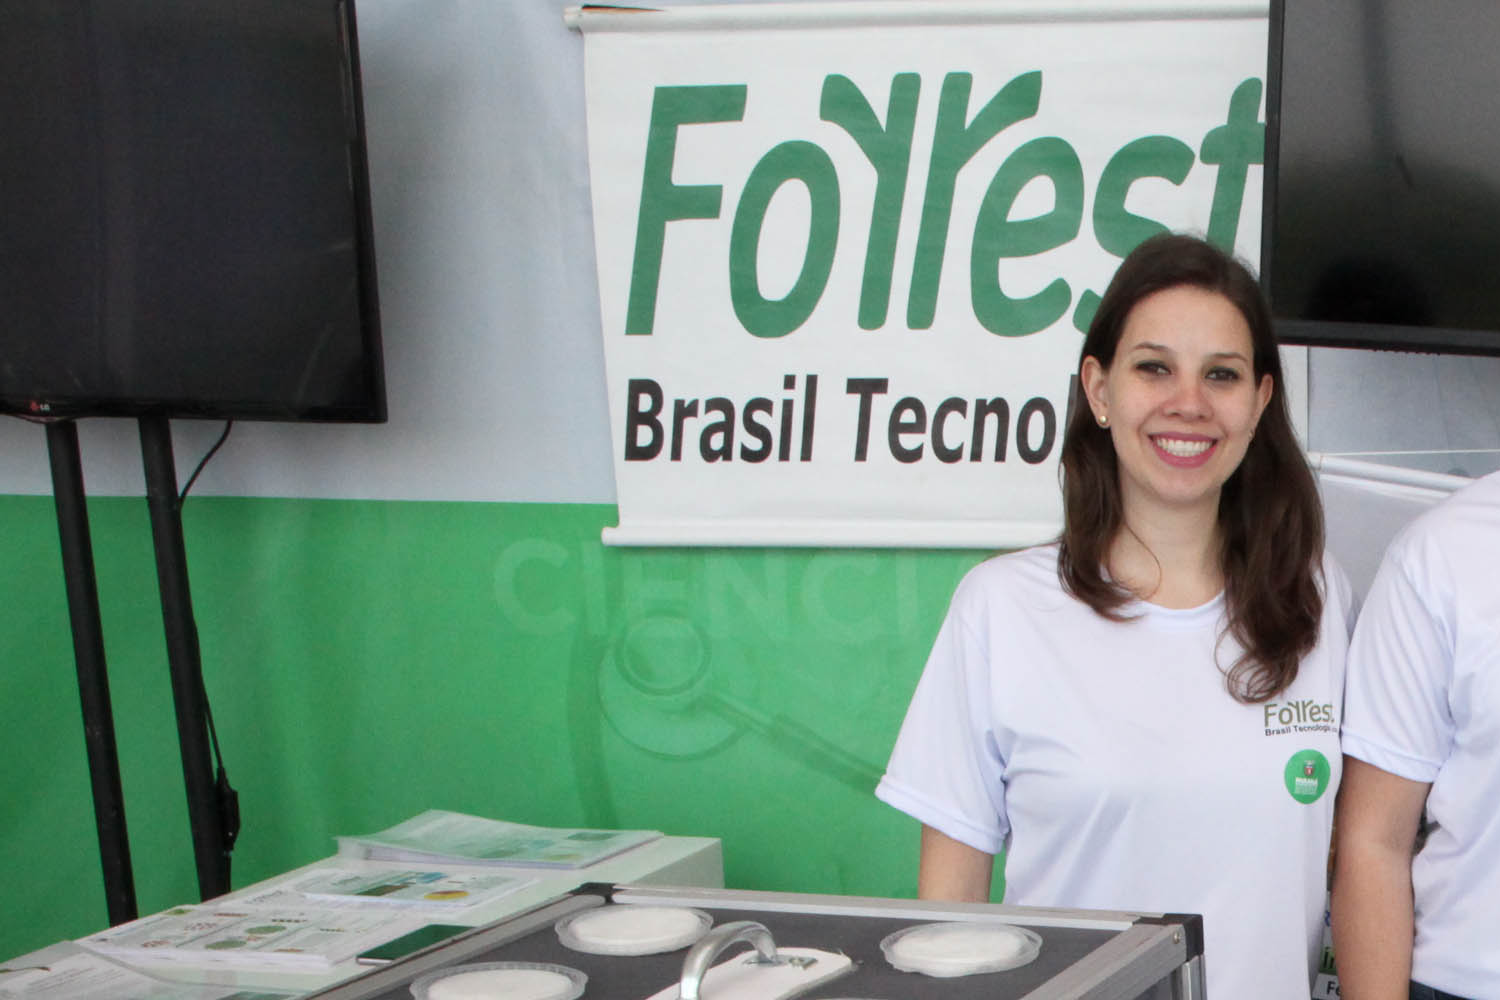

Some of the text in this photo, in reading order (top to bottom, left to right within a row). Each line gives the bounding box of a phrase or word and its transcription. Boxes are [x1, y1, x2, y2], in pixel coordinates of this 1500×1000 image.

[625, 70, 1267, 338] Forrest
[624, 374, 818, 462] Brasil
[1264, 700, 1335, 727] Forres
[1265, 727, 1291, 736] Brasil
[1293, 724, 1330, 734] Tecnologi
